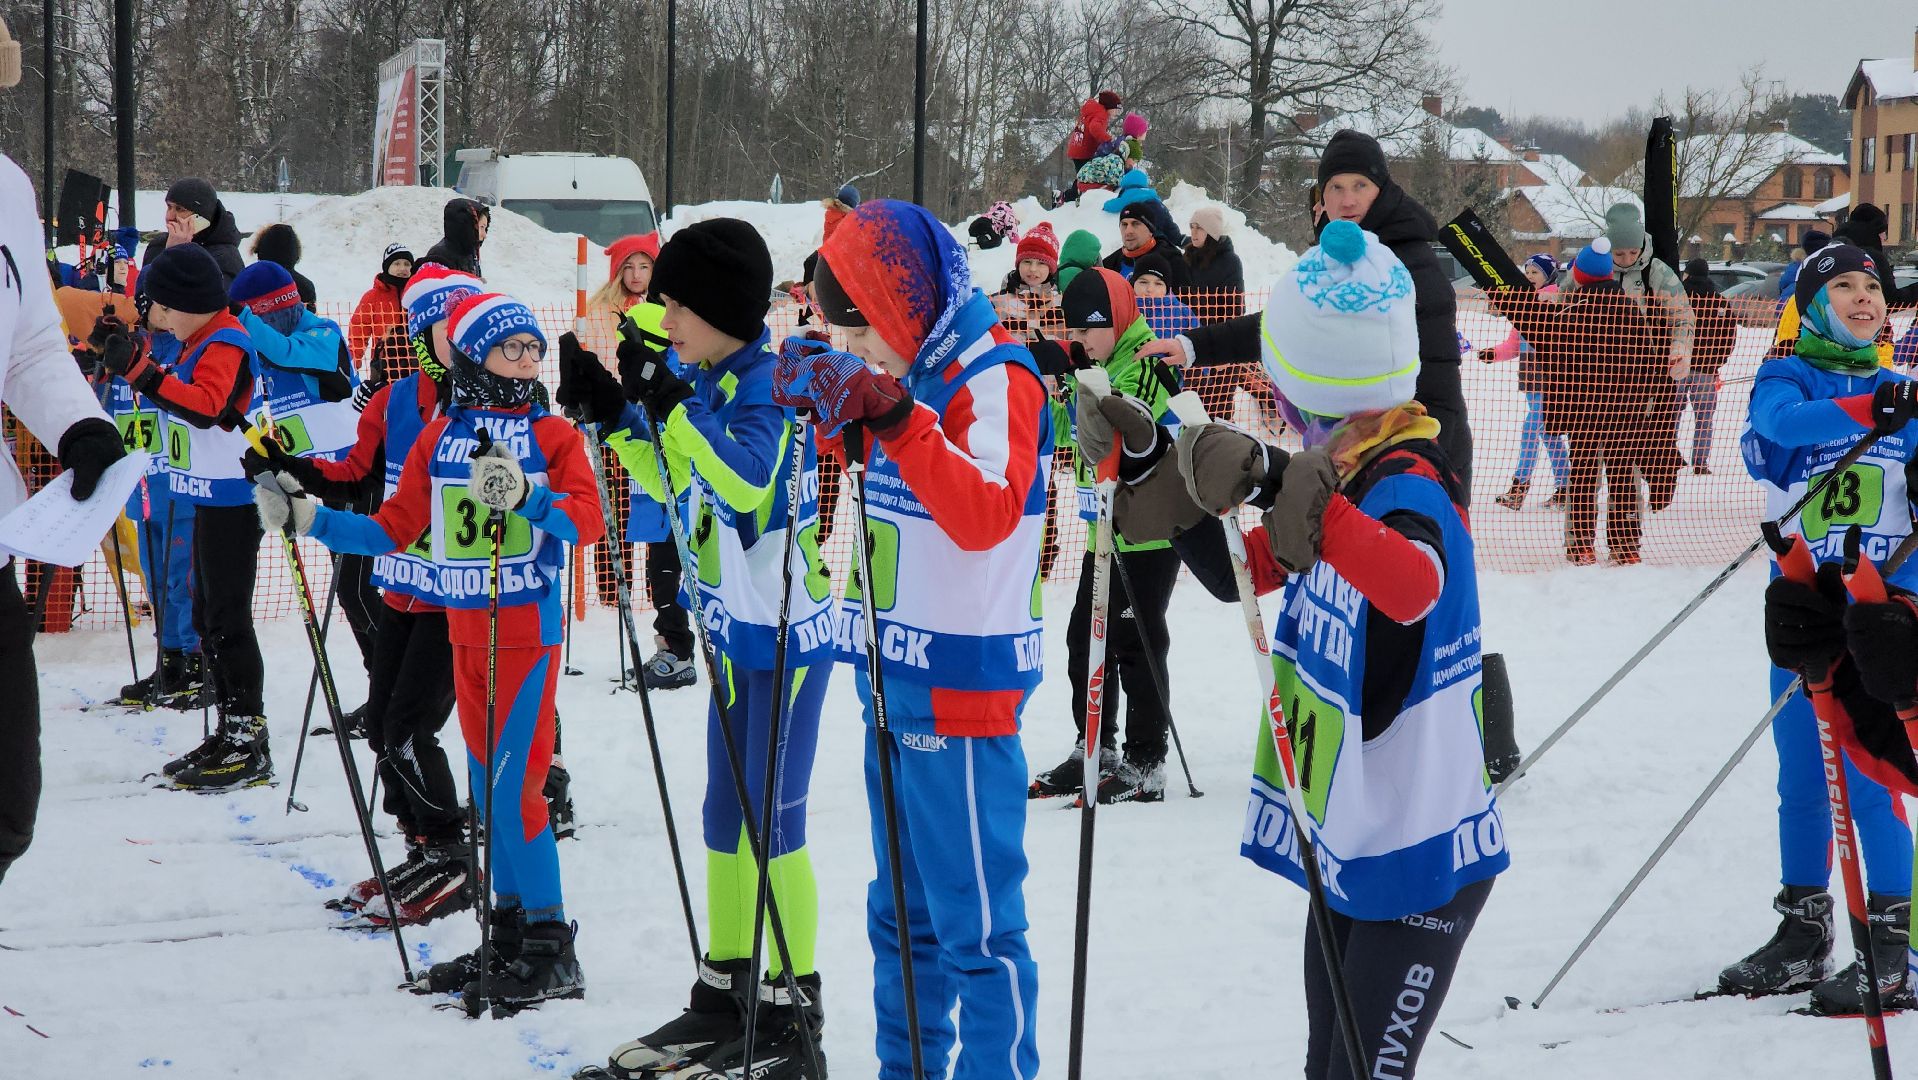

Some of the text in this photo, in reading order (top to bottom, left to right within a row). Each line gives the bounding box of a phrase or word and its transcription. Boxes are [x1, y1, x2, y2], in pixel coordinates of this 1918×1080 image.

[1448, 223, 1505, 286] FISCHER
[924, 329, 961, 369] SKINSK
[123, 419, 153, 450] 45
[788, 447, 800, 512] NORDWAY
[455, 498, 508, 549] 34
[876, 692, 886, 728] NORDWAY
[901, 732, 949, 750] SKINSK
